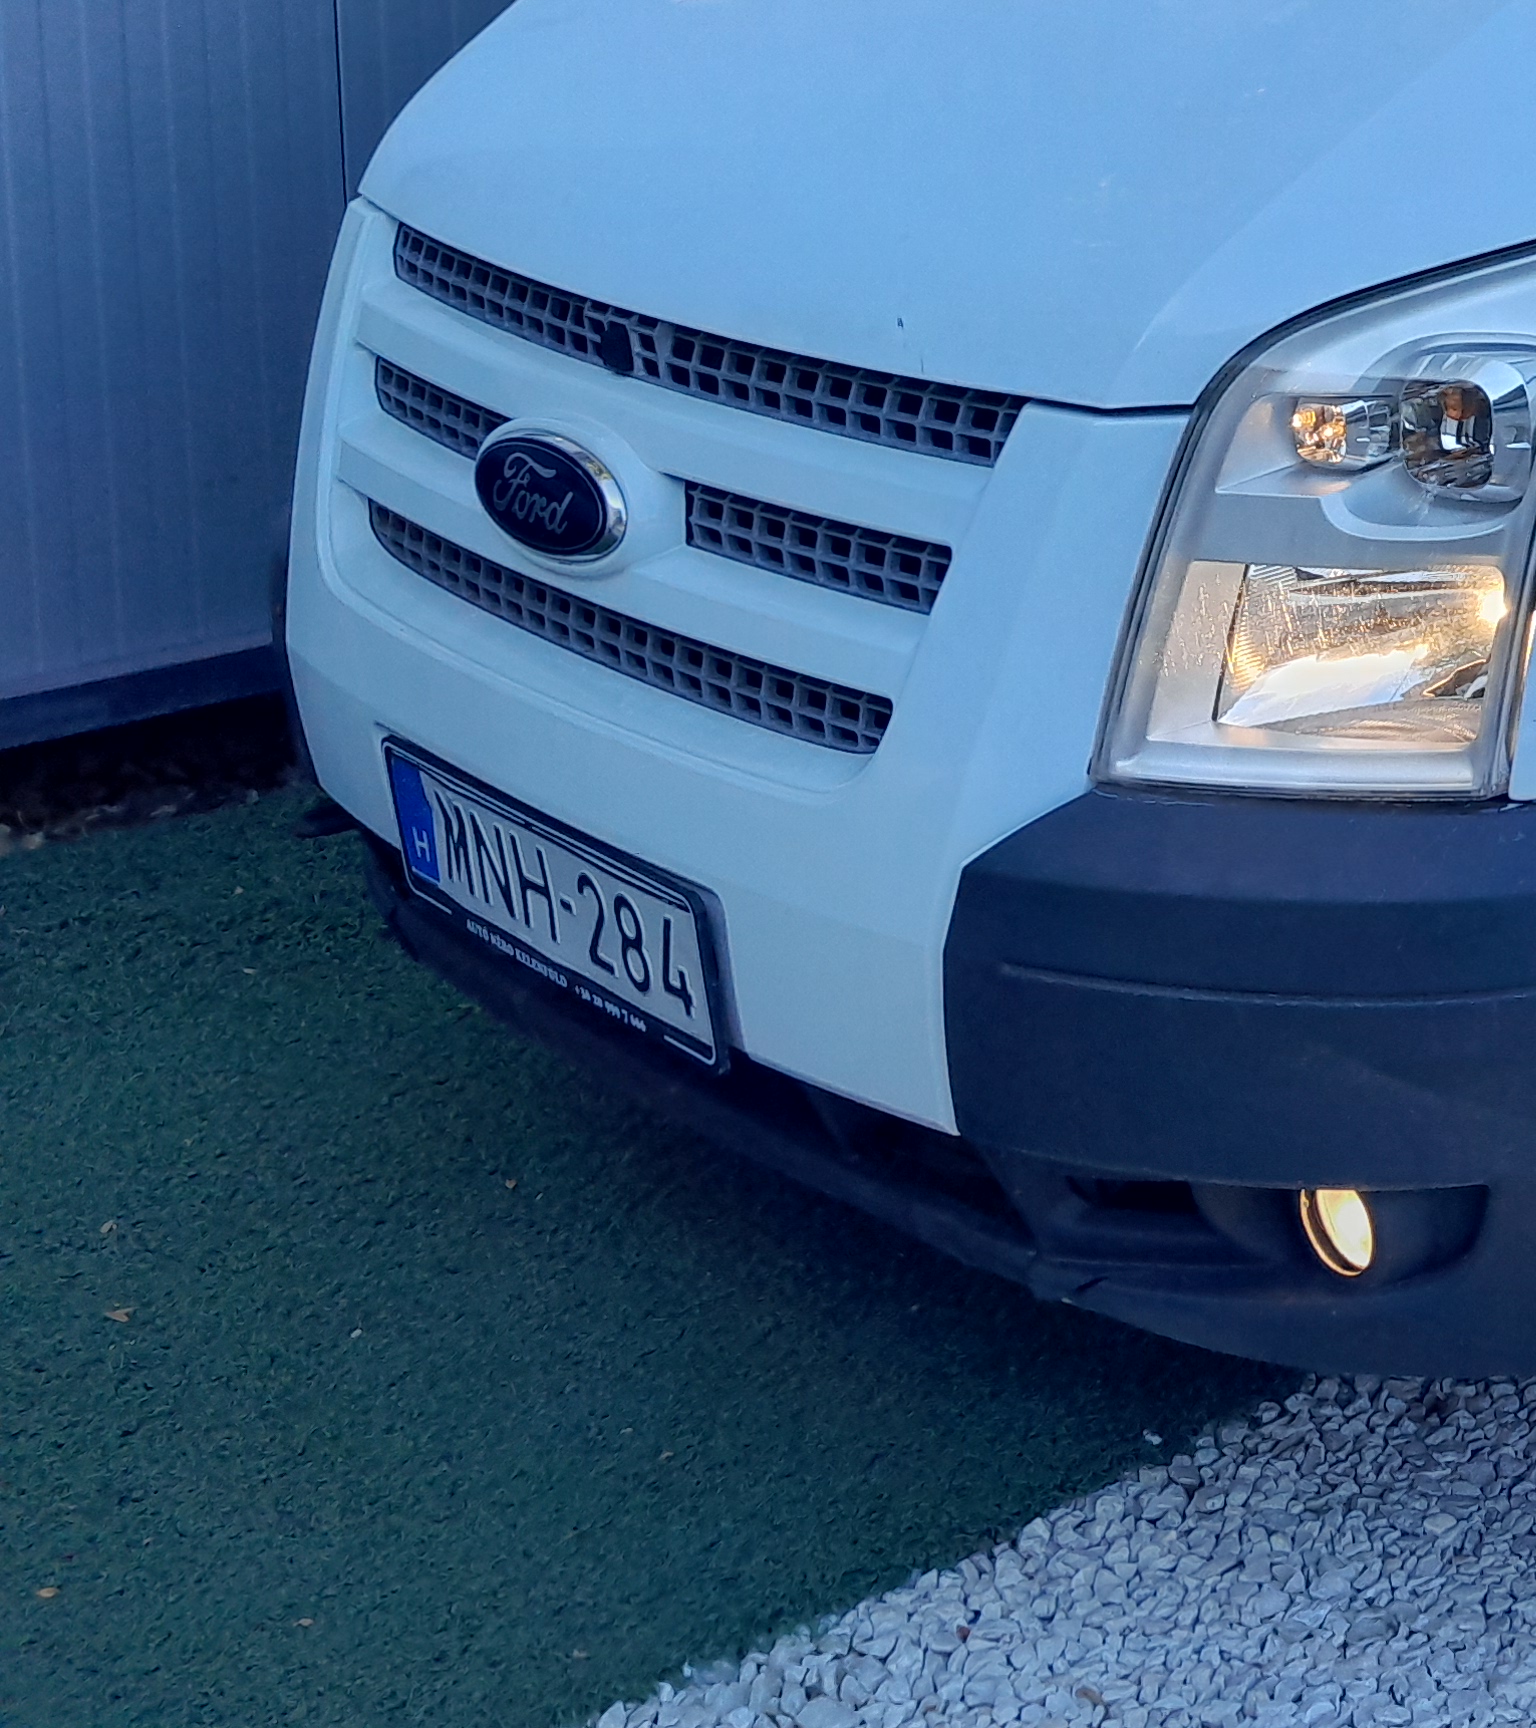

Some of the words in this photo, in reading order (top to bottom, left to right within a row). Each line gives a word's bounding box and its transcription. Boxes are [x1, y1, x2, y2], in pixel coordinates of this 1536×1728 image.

[493, 452, 574, 534] Ford
[412, 825, 431, 863] H
[433, 789, 697, 1020] MNH-284
